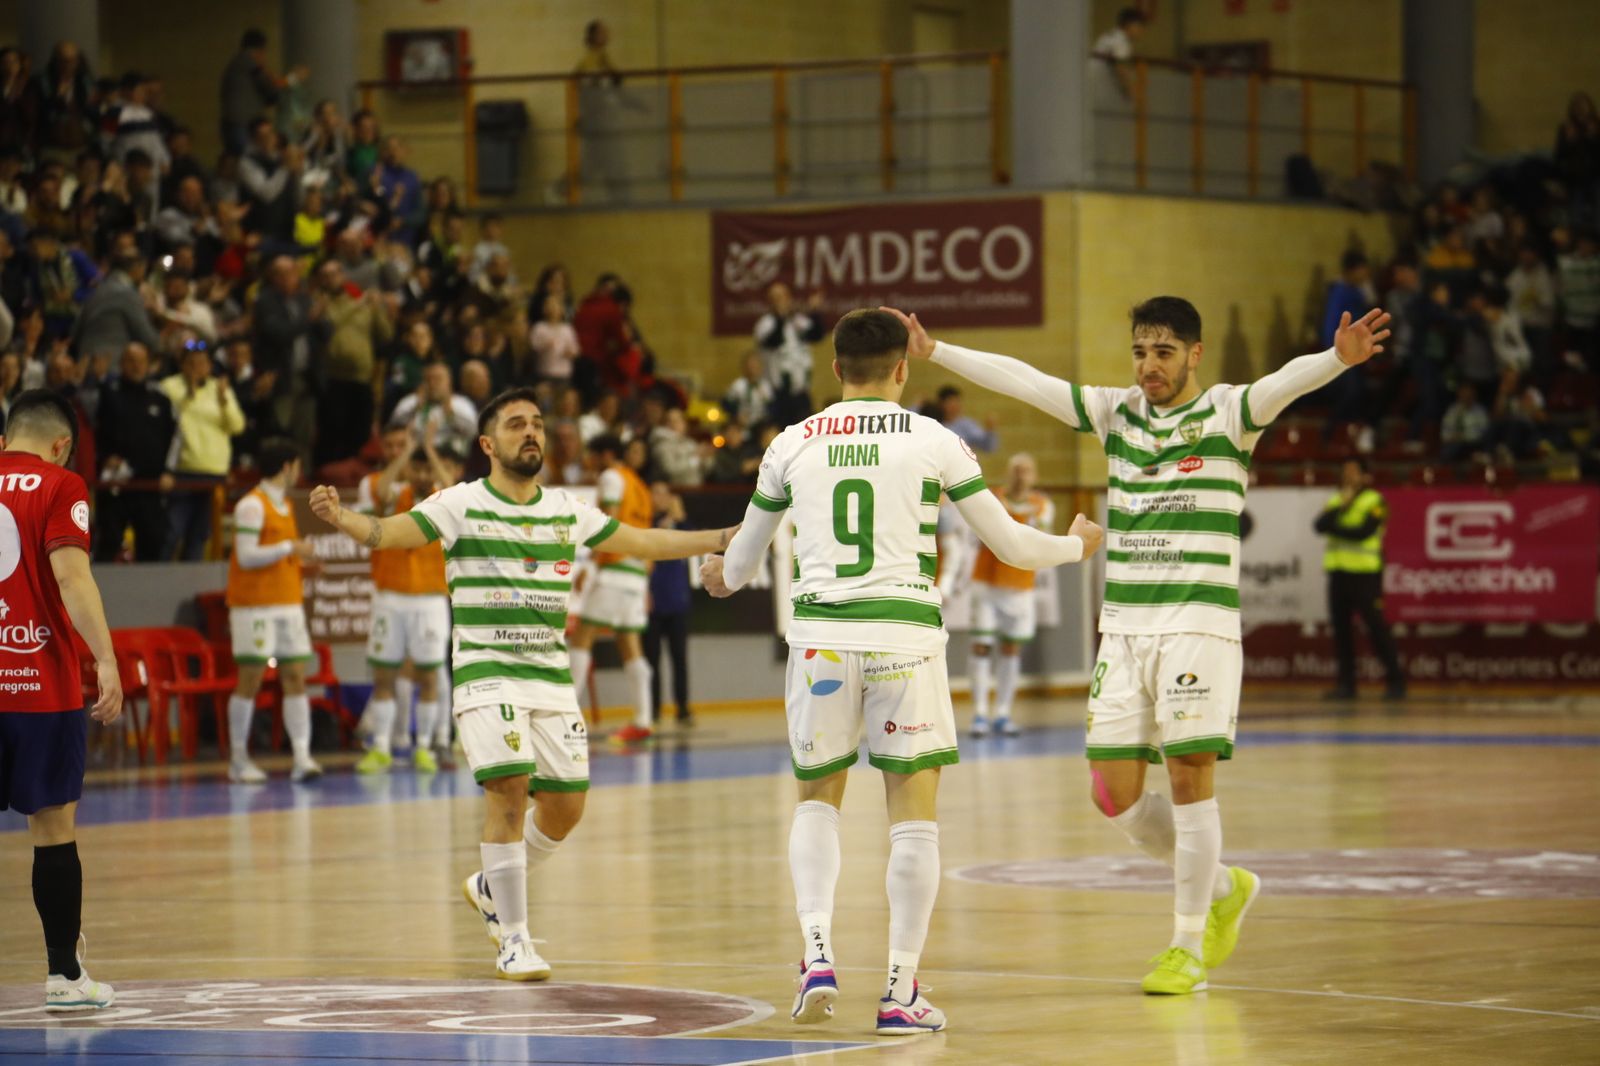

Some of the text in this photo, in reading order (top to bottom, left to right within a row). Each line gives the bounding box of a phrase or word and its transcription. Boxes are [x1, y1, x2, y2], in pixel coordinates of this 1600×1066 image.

[793, 225, 1033, 287] IMDECO
[803, 413, 912, 439] STILOTEXTIL
[828, 444, 880, 467] VIANA
[833, 478, 875, 579] 9
[0, 619, 51, 643] rale
[1091, 661, 1109, 699] 8
